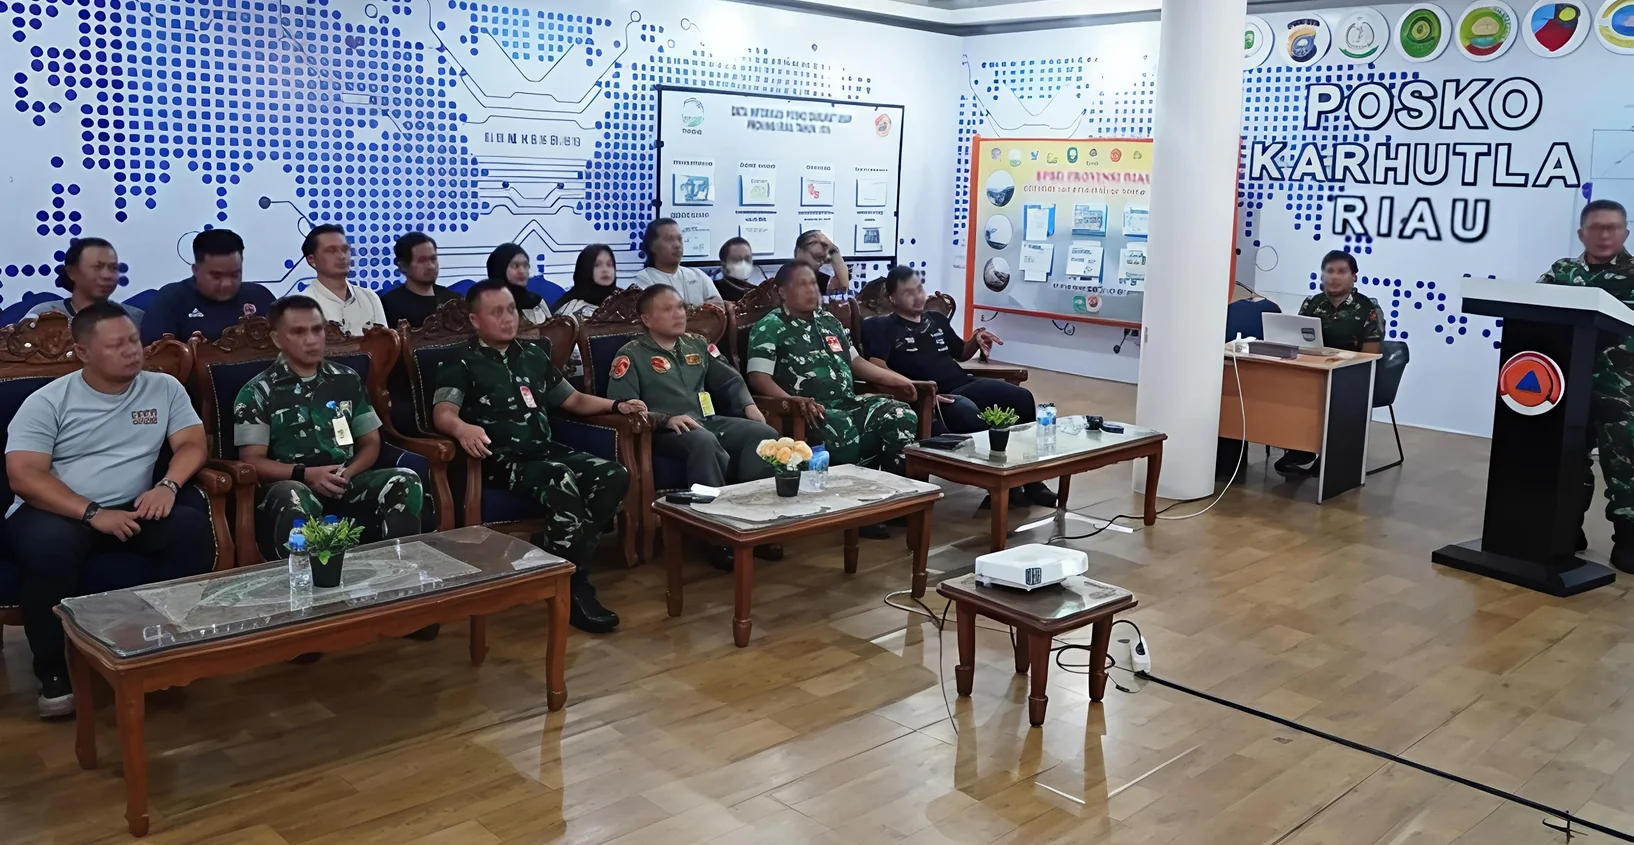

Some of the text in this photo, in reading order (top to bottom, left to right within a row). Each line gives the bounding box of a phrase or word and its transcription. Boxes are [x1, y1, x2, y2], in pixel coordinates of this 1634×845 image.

[1303, 76, 1543, 131] POSKO
[1250, 141, 1581, 188] KARHUTLA
[1332, 194, 1491, 244] RIAU
